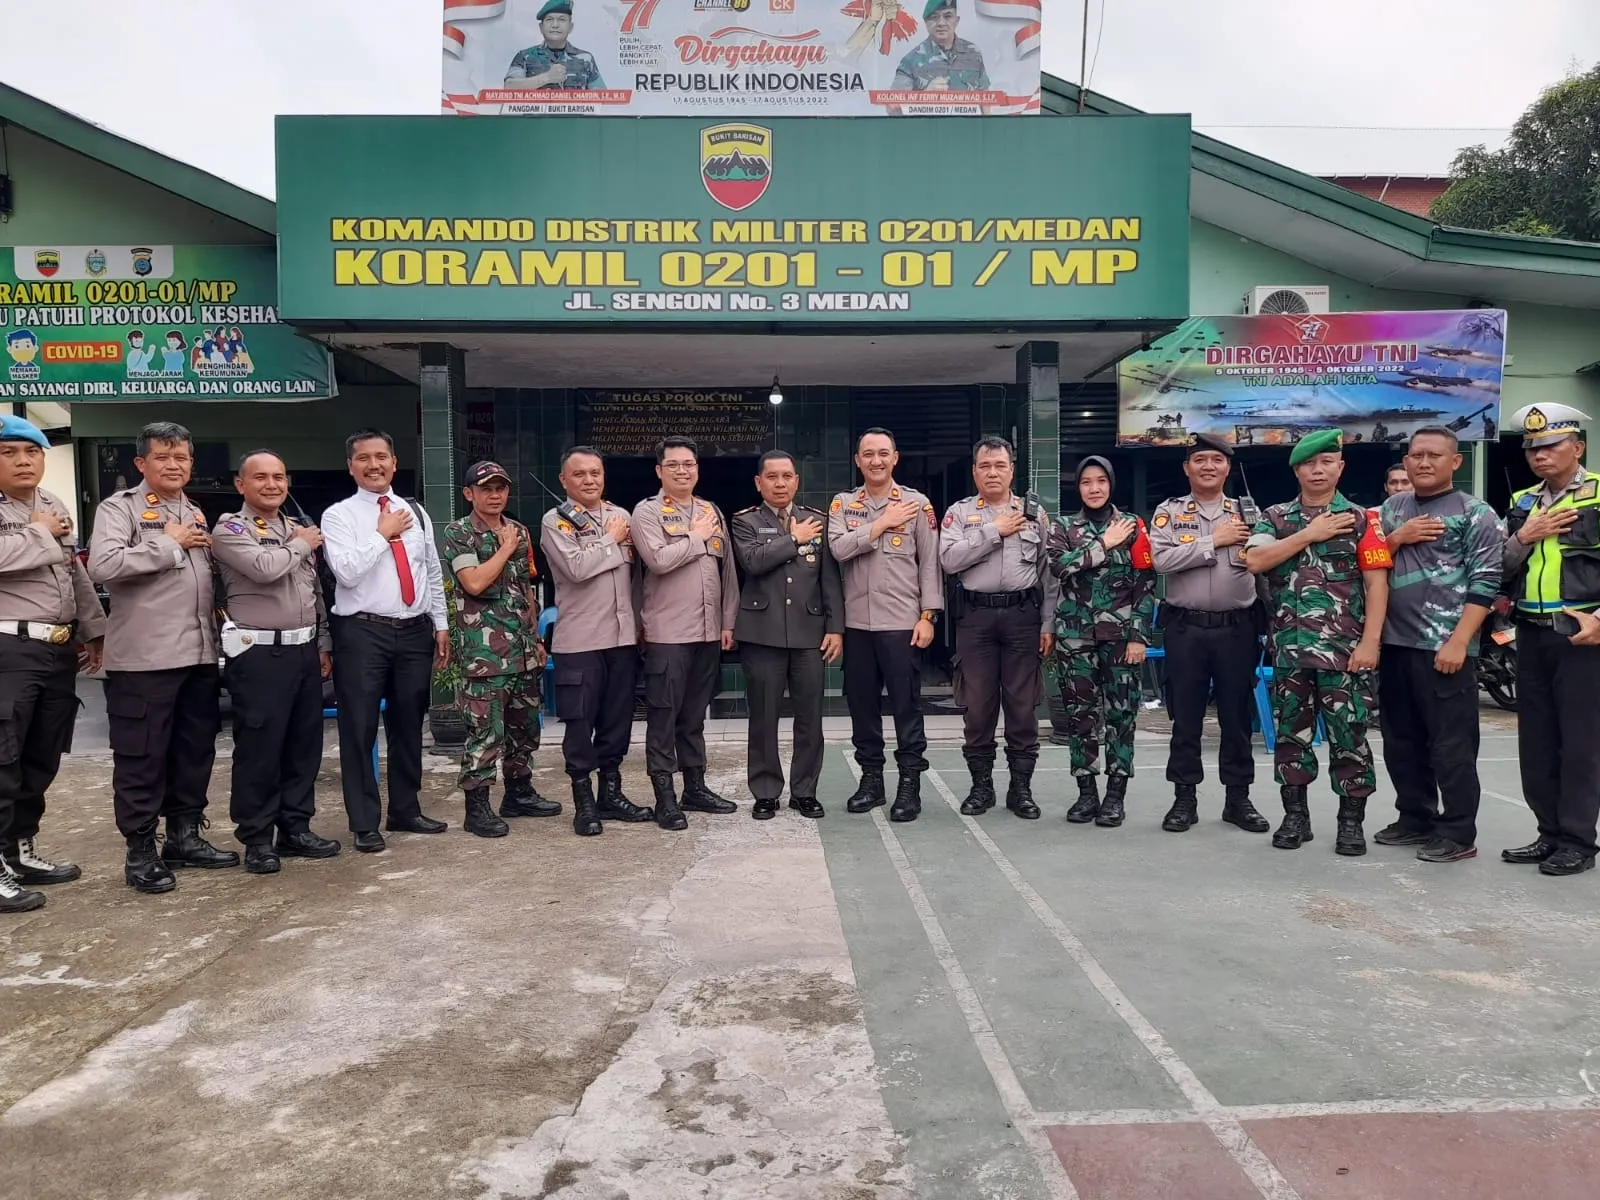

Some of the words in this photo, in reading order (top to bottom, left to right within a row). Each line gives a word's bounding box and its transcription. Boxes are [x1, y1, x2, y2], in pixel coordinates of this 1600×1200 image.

[772, 0, 791, 10] CK
[674, 35, 827, 70] Dirgahayu
[635, 73, 739, 91] REPUBLIK
[745, 73, 864, 91] INDONESIA
[508, 104, 540, 113] PANGDAM
[548, 104, 567, 113] BUKIT
[567, 104, 595, 113] BARISAN
[908, 105, 934, 114] DANDIM
[954, 106, 977, 114] MEDAN
[710, 132, 732, 143] BUKIT
[732, 131, 763, 143] BARISAN
[331, 218, 534, 241] KOMANDO
[545, 219, 700, 242] DISTRIK
[712, 219, 867, 243] MILITER
[879, 218, 1139, 242] 0201/MEDAN
[334, 249, 640, 286] KORAMIL
[660, 250, 817, 287] 0201
[881, 250, 953, 287] 01
[1030, 248, 1137, 285] MP
[87, 280, 236, 304] 0201-01/MP
[565, 293, 604, 310] JL.
[611, 293, 721, 311] SENGON
[730, 293, 774, 310] No.
[782, 293, 799, 310] 3
[807, 293, 910, 310] MEDAN
[14, 307, 84, 325] PATUHI
[90, 306, 195, 325] PROTOKOL
[201, 305, 284, 324] KESEHA
[46, 344, 118, 359] COVID-19
[1205, 344, 1364, 365] DIRGAHAYU
[1373, 343, 1419, 363] TNI
[1226, 367, 1274, 375] OKTOBER
[20, 383, 79, 396] SAYANGI
[83, 382, 117, 396] DIRI,
[121, 381, 195, 394] KELUARGA
[200, 381, 228, 394] DAN
[233, 381, 281, 393] ORANG
[285, 380, 316, 393] LAIN
[1243, 376, 1267, 386] TNI
[1272, 376, 1337, 386] ADALAH
[1343, 374, 1378, 385] KITA
[613, 393, 661, 402] TUGAS
[665, 393, 713, 402] POKOK
[720, 393, 743, 402] TNI
